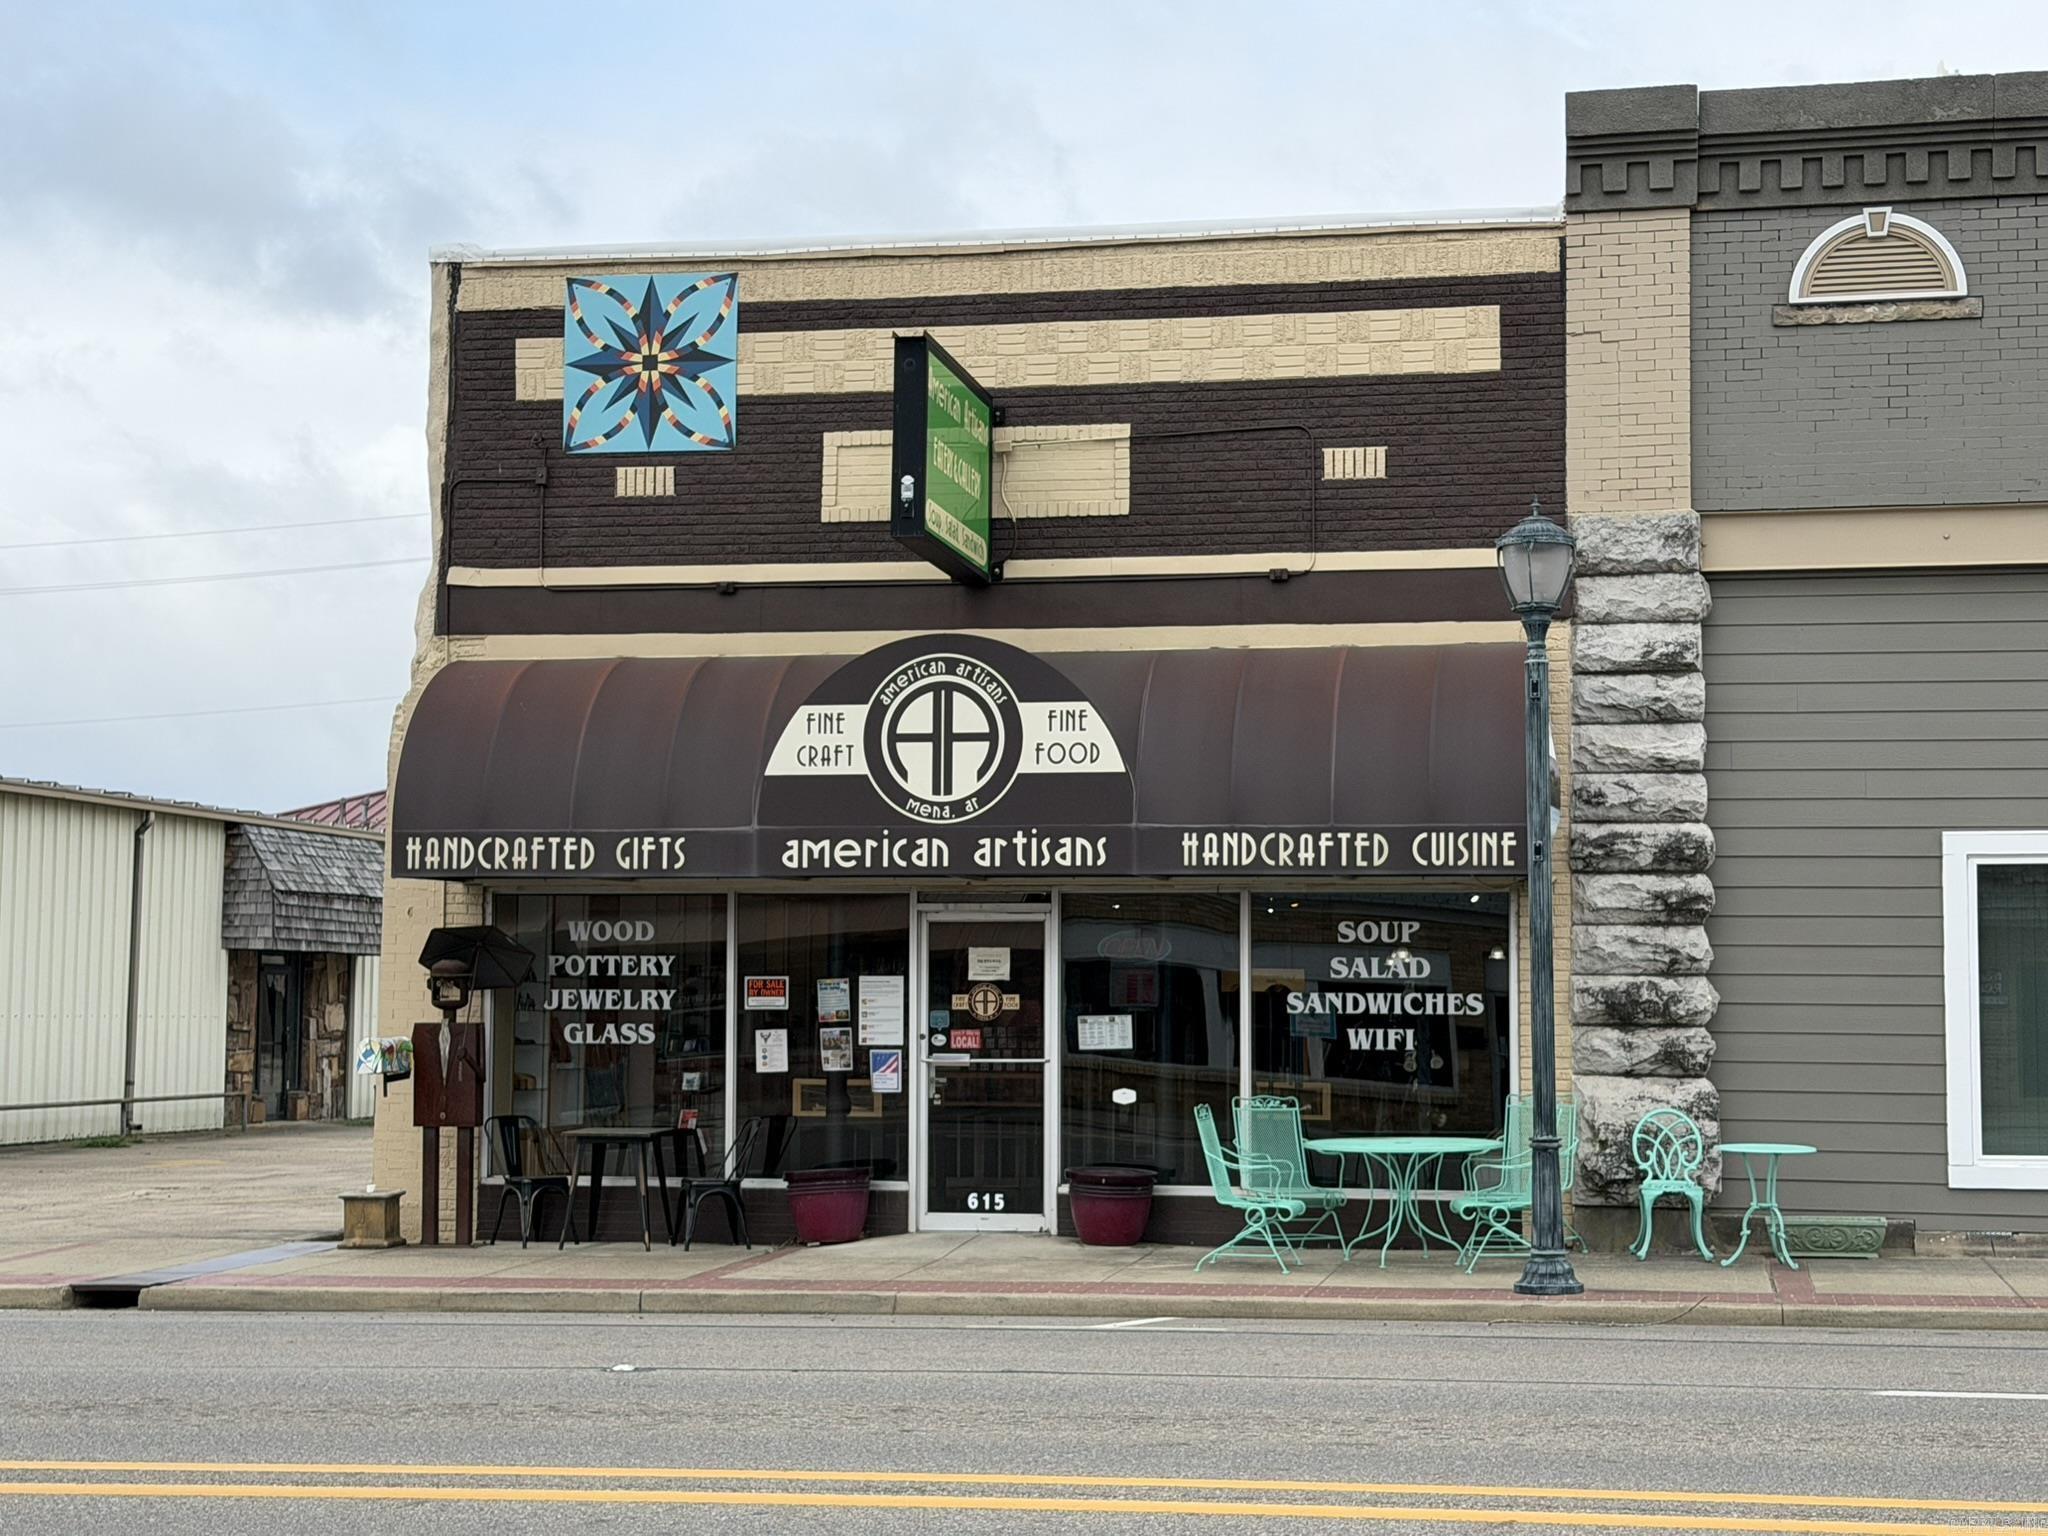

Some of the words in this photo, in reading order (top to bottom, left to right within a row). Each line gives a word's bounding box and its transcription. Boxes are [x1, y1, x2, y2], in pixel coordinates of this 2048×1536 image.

[879, 660, 946, 706] american
[955, 662, 1008, 704] artisans
[806, 712, 845, 735] FINE
[1047, 709, 1088, 732] FINE
[796, 744, 854, 767] CRAFT
[1035, 742, 1100, 765] FOOD
[964, 797, 980, 813] ar
[406, 837, 595, 870] HANDCRAFTED
[615, 836, 686, 870] GIFTS
[781, 829, 949, 869] american
[973, 828, 1107, 867] artisans
[1181, 832, 1389, 867] HANDCRAFTED
[1412, 831, 1517, 866] CUISINE
[568, 920, 655, 941] WOOD
[1337, 921, 1420, 943] SOUP
[548, 955, 676, 976] POTTERY
[1329, 956, 1432, 980] SALAD
[749, 979, 764, 989] FOR
[766, 979, 785, 989] SALE
[760, 989, 785, 997] OWNER
[543, 988, 677, 1011] JEWELRY
[1286, 992, 1486, 1017] SANDWICHES
[562, 1022, 656, 1045] GLASS
[1346, 1028, 1416, 1051] WIFI
[967, 1192, 1005, 1211] 615
